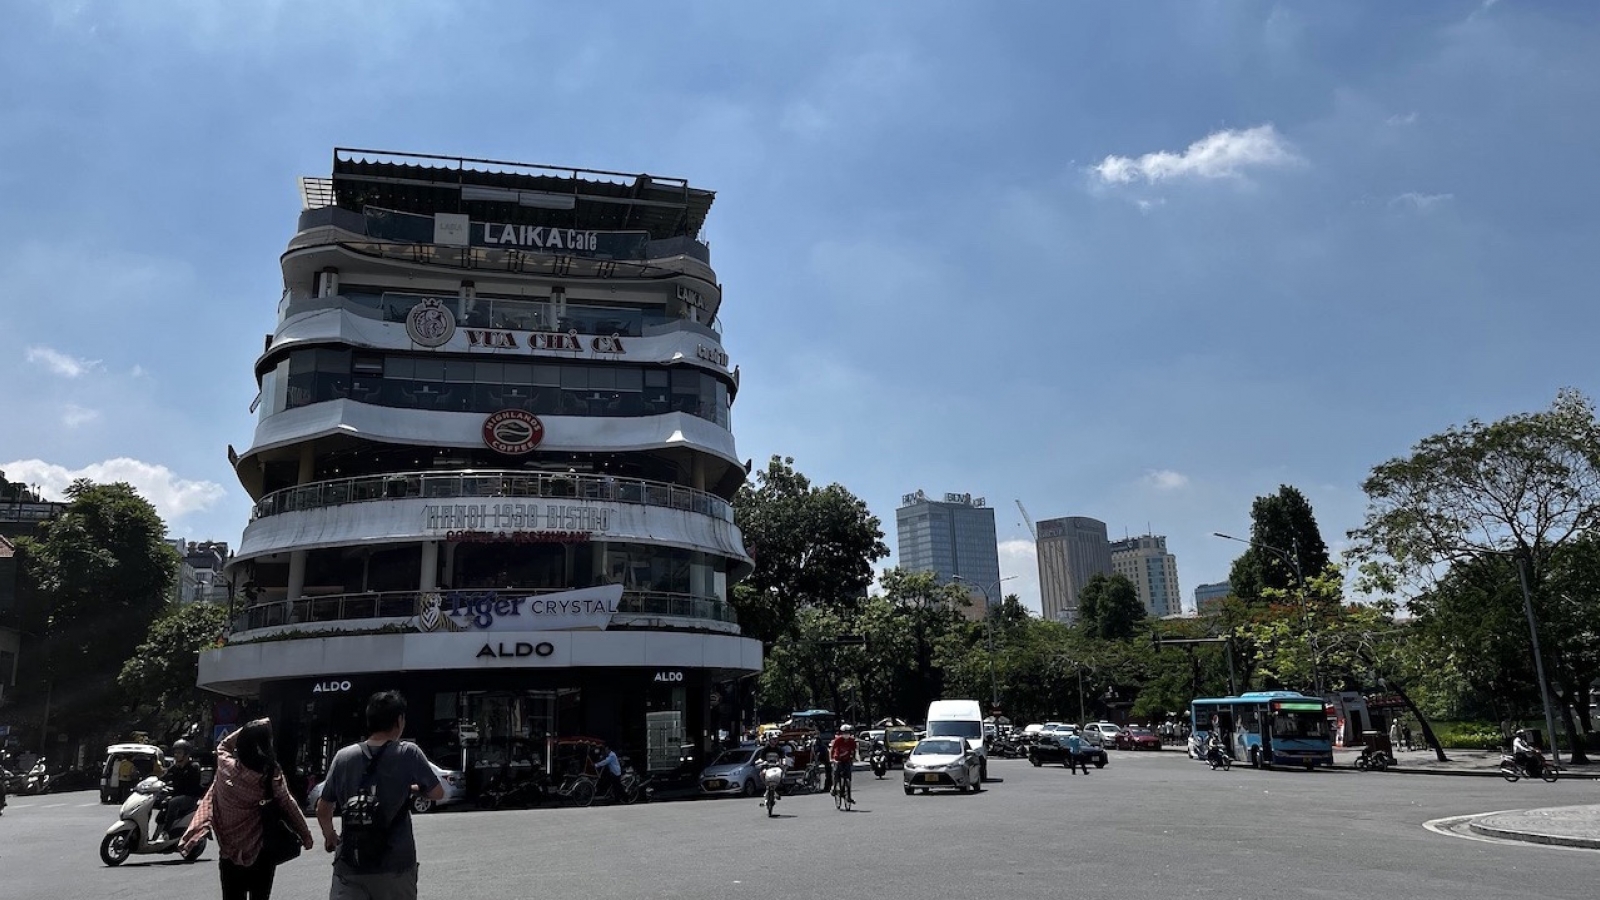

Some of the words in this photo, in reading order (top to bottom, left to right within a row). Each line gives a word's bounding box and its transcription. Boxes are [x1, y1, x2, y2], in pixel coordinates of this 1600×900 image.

[484, 222, 563, 248] LAIKA
[567, 229, 597, 250] Café
[464, 329, 520, 349] VUA
[527, 328, 584, 352] CHẢ
[486, 412, 541, 431] HIGHLANDS
[492, 441, 534, 452] COFFEE
[426, 505, 486, 529] HANOI
[493, 504, 538, 528] 1930
[546, 505, 611, 531] BISTRO
[449, 590, 526, 629] Tiger
[531, 600, 618, 614] CRYSTAL
[476, 642, 554, 658] ALDO
[654, 672, 683, 681] ALDO
[312, 681, 351, 692] ALDO
